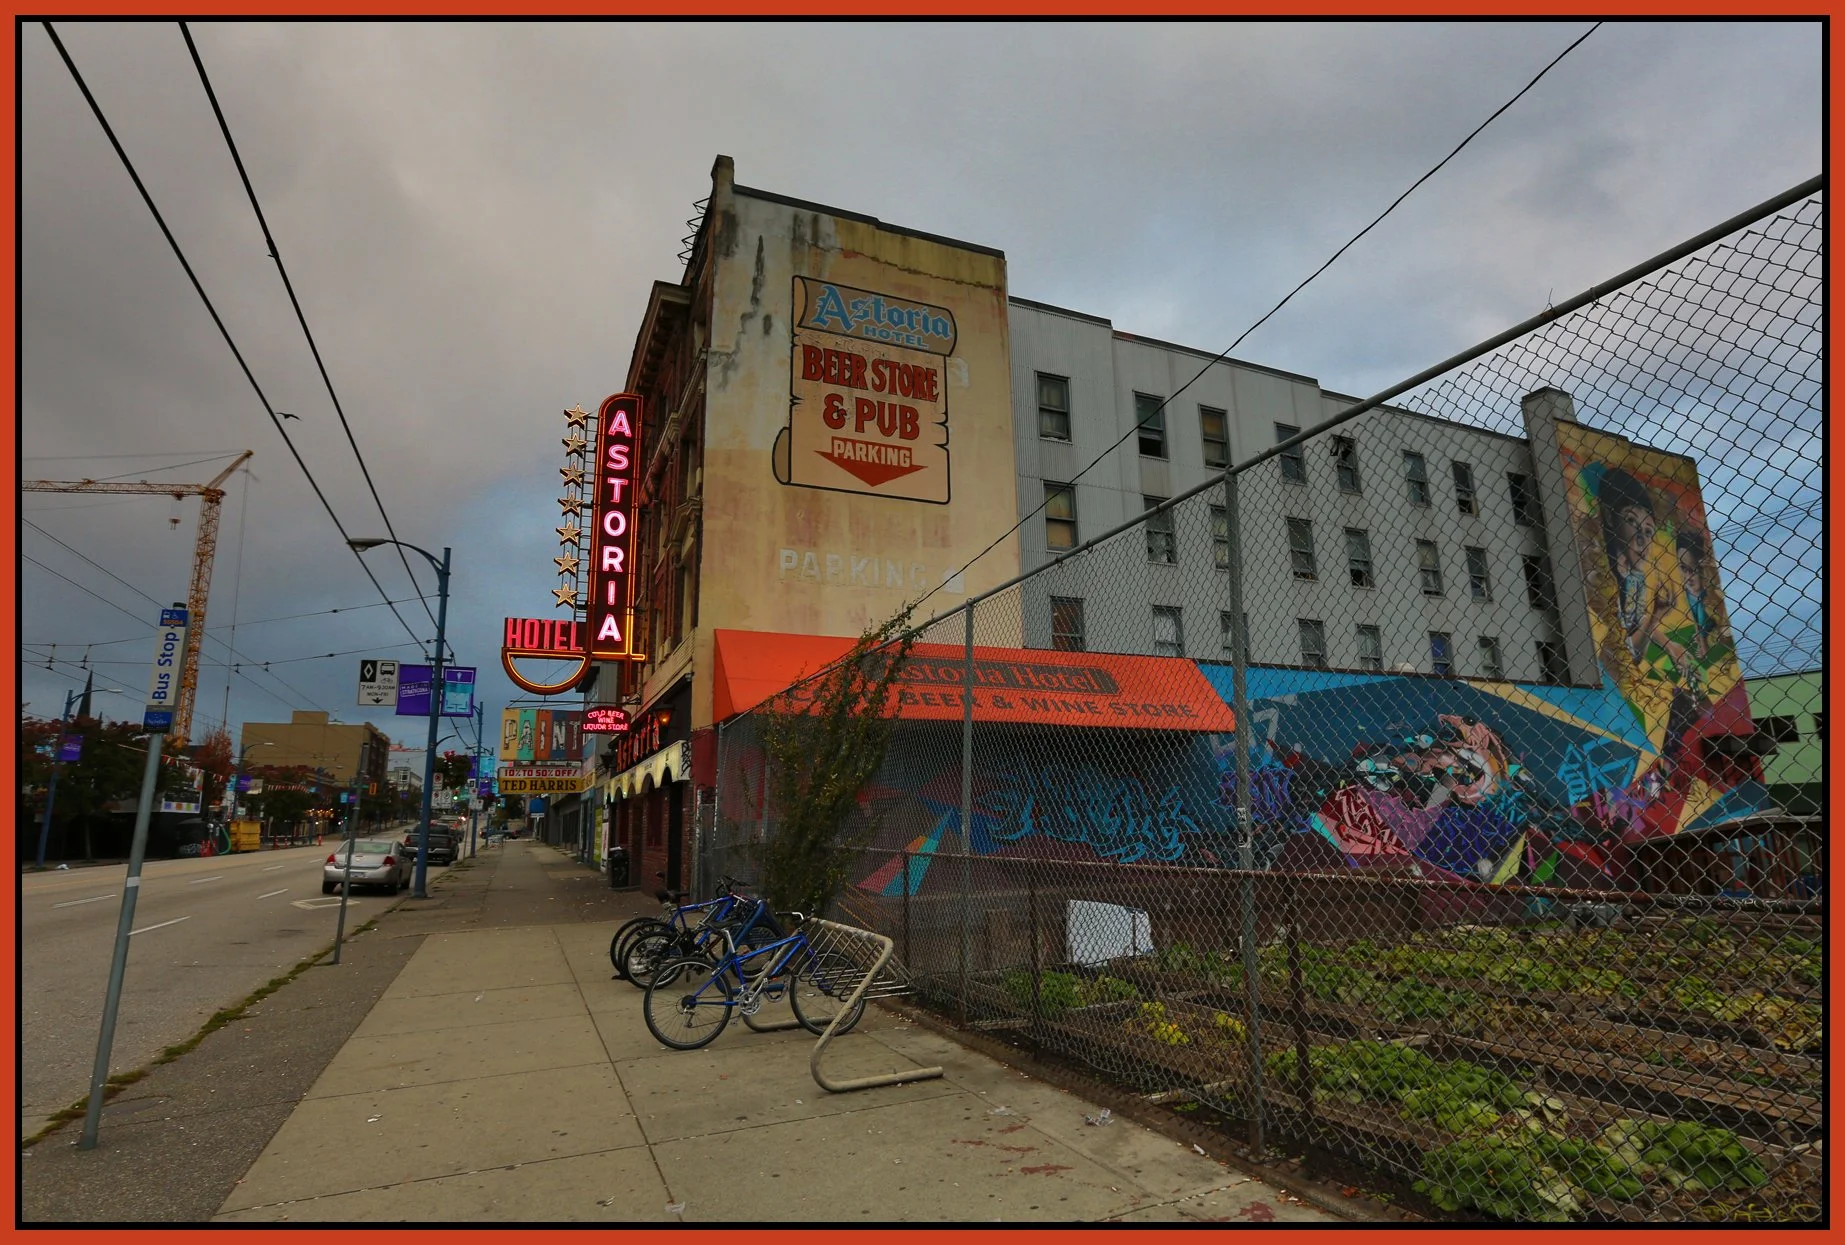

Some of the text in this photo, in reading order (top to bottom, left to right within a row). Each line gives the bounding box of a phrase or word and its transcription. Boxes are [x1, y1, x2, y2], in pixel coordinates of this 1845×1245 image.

[809, 284, 953, 340] Astoria
[863, 326, 929, 349] HOTEL
[801, 345, 868, 391] BEER
[871, 358, 940, 404] STORE
[823, 392, 920, 441] & PUB
[832, 440, 912, 468] PARKING
[597, 410, 632, 642] ASTORIA
[779, 549, 927, 591] PARKING
[507, 617, 584, 651] HOTEL
[158, 632, 180, 667] Stop
[152, 672, 171, 700] Bus
[1010, 666, 1102, 690] Hotel
[587, 709, 625, 720] COLD BEER
[901, 691, 1198, 719] BEER & WINE STORE
[504, 719, 580, 750] PAINT
[583, 723, 629, 731] LIQUOR STORE
[502, 780, 527, 791] TED
[530, 779, 577, 790] HARRIS
[504, 769, 521, 777] 10%
[536, 769, 553, 777] 50%
[555, 769, 578, 777] OFF!
